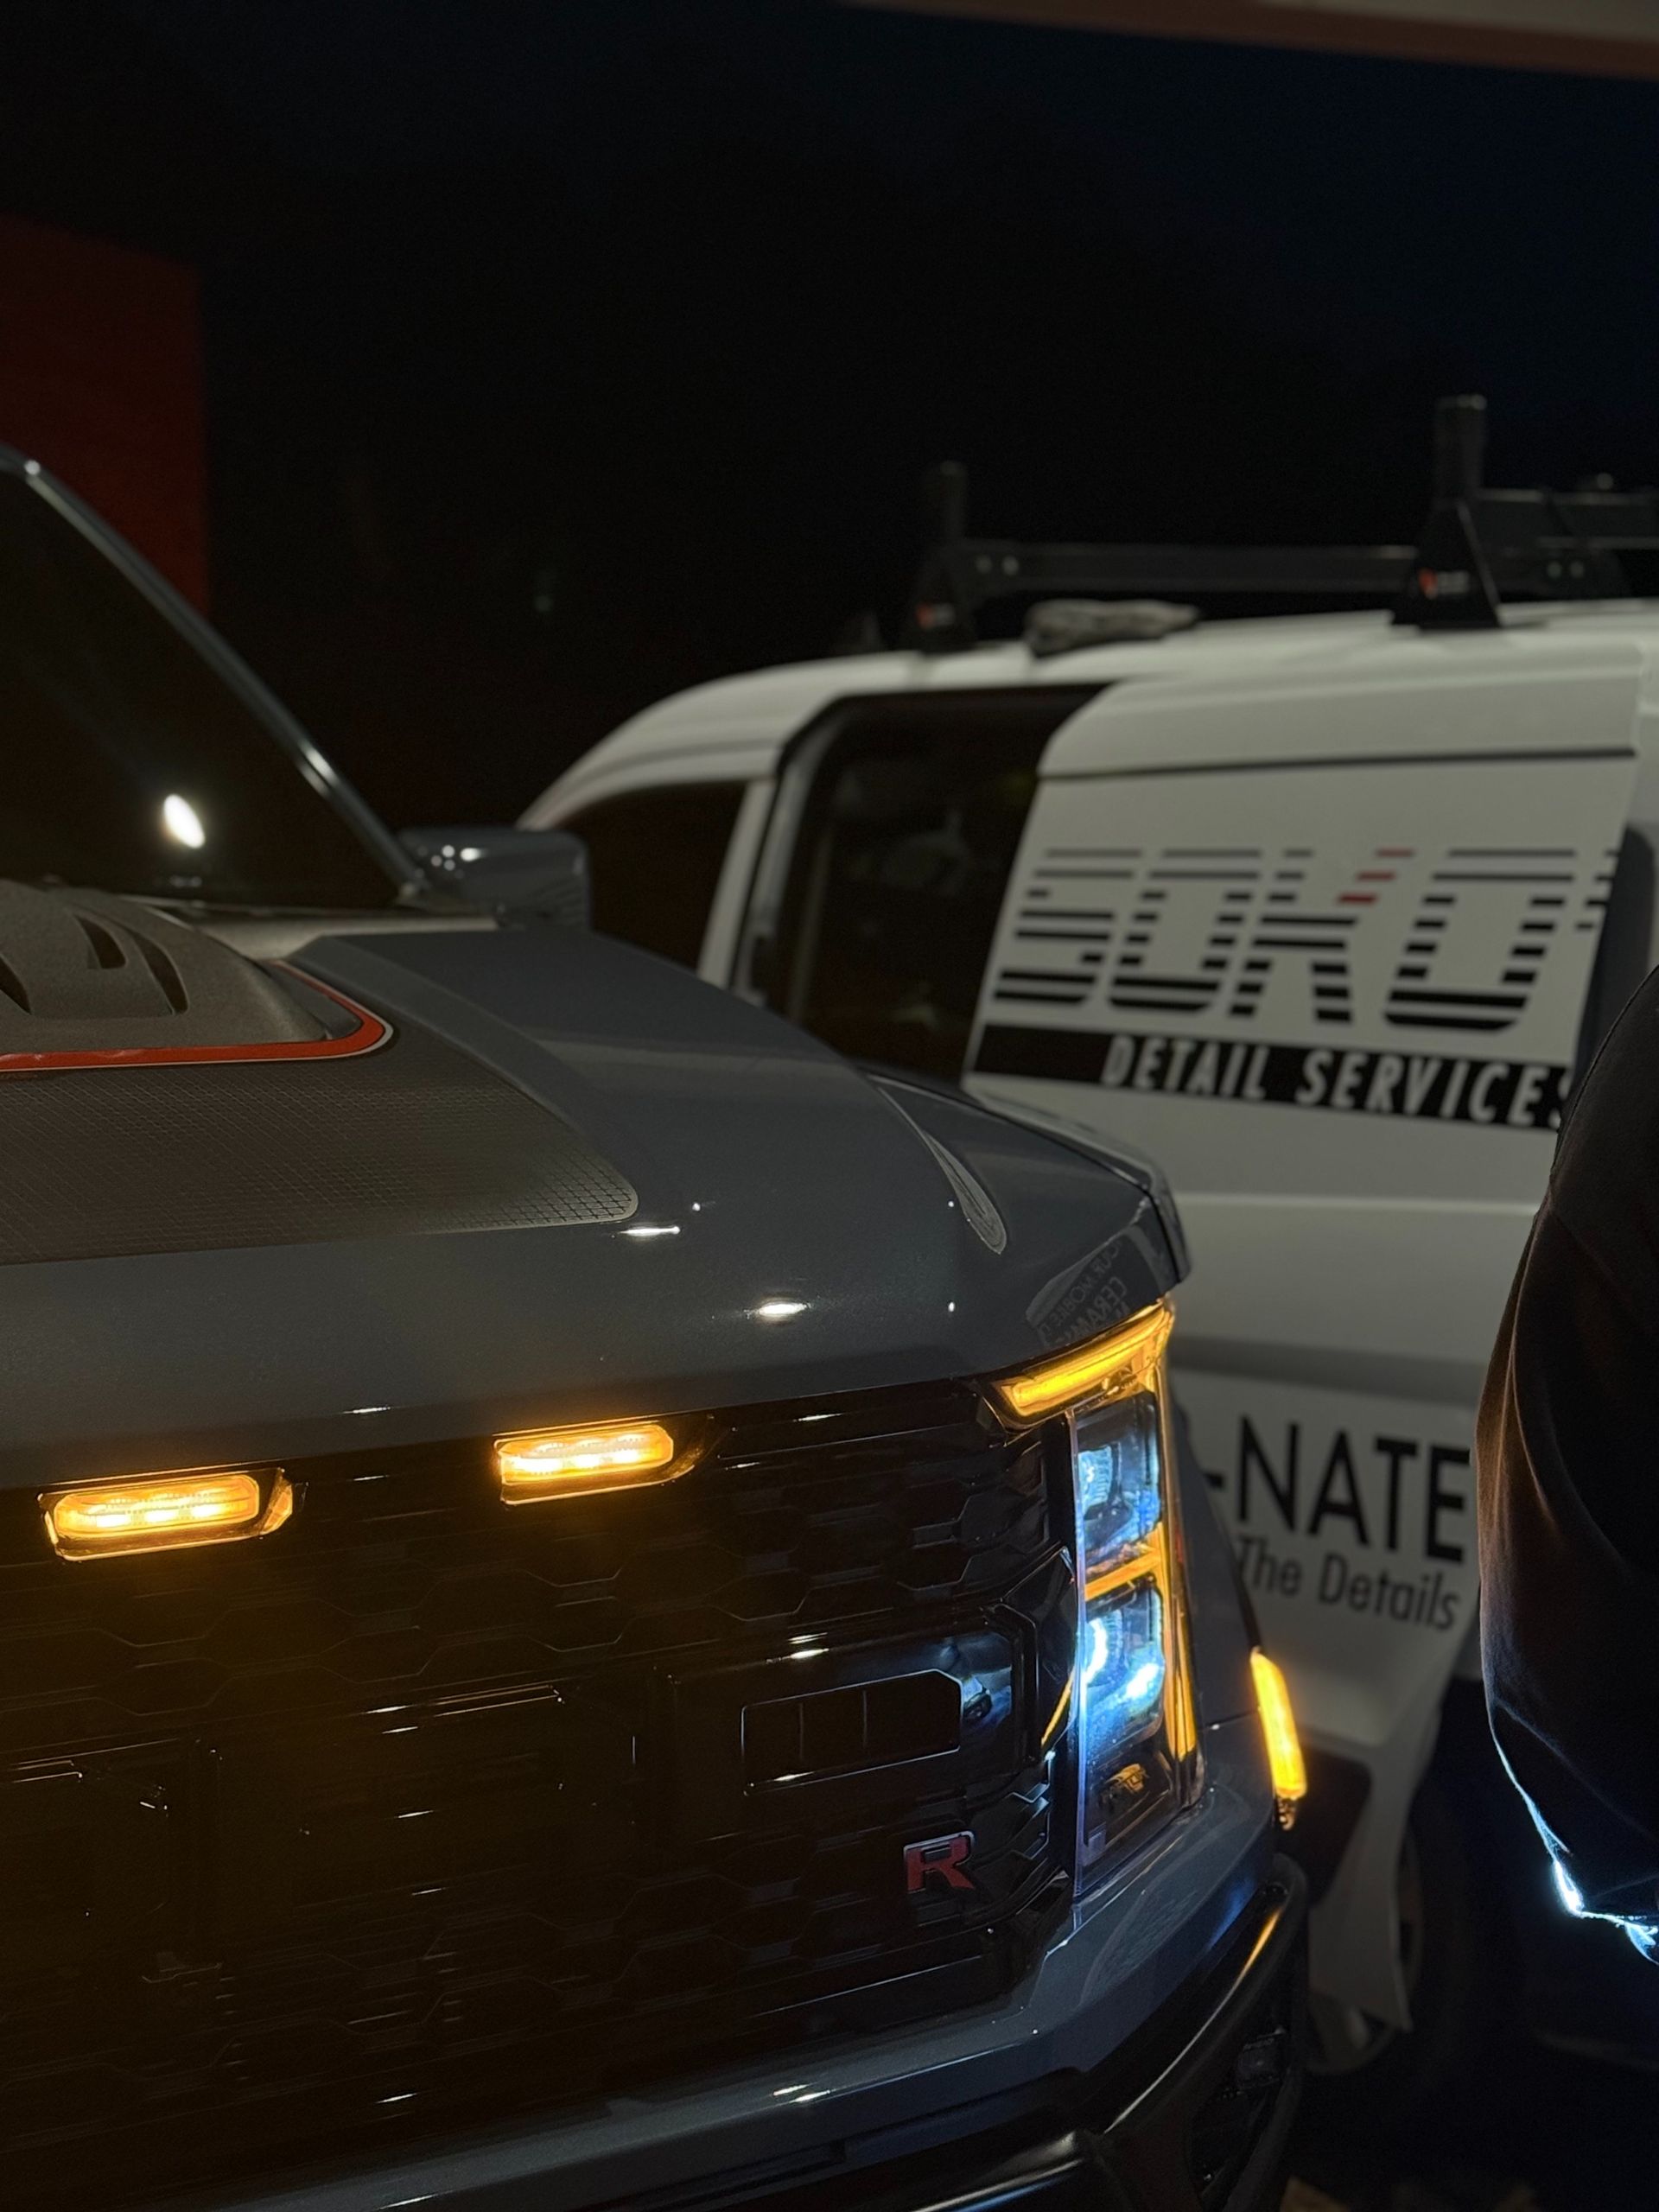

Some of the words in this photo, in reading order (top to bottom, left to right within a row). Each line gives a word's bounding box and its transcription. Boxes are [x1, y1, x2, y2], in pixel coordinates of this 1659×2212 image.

[1101, 1034, 1268, 1102] DETAIL
[1238, 1532, 1302, 1598] The
[1319, 1551, 1460, 1630] Details
[903, 1830, 976, 1894] R
